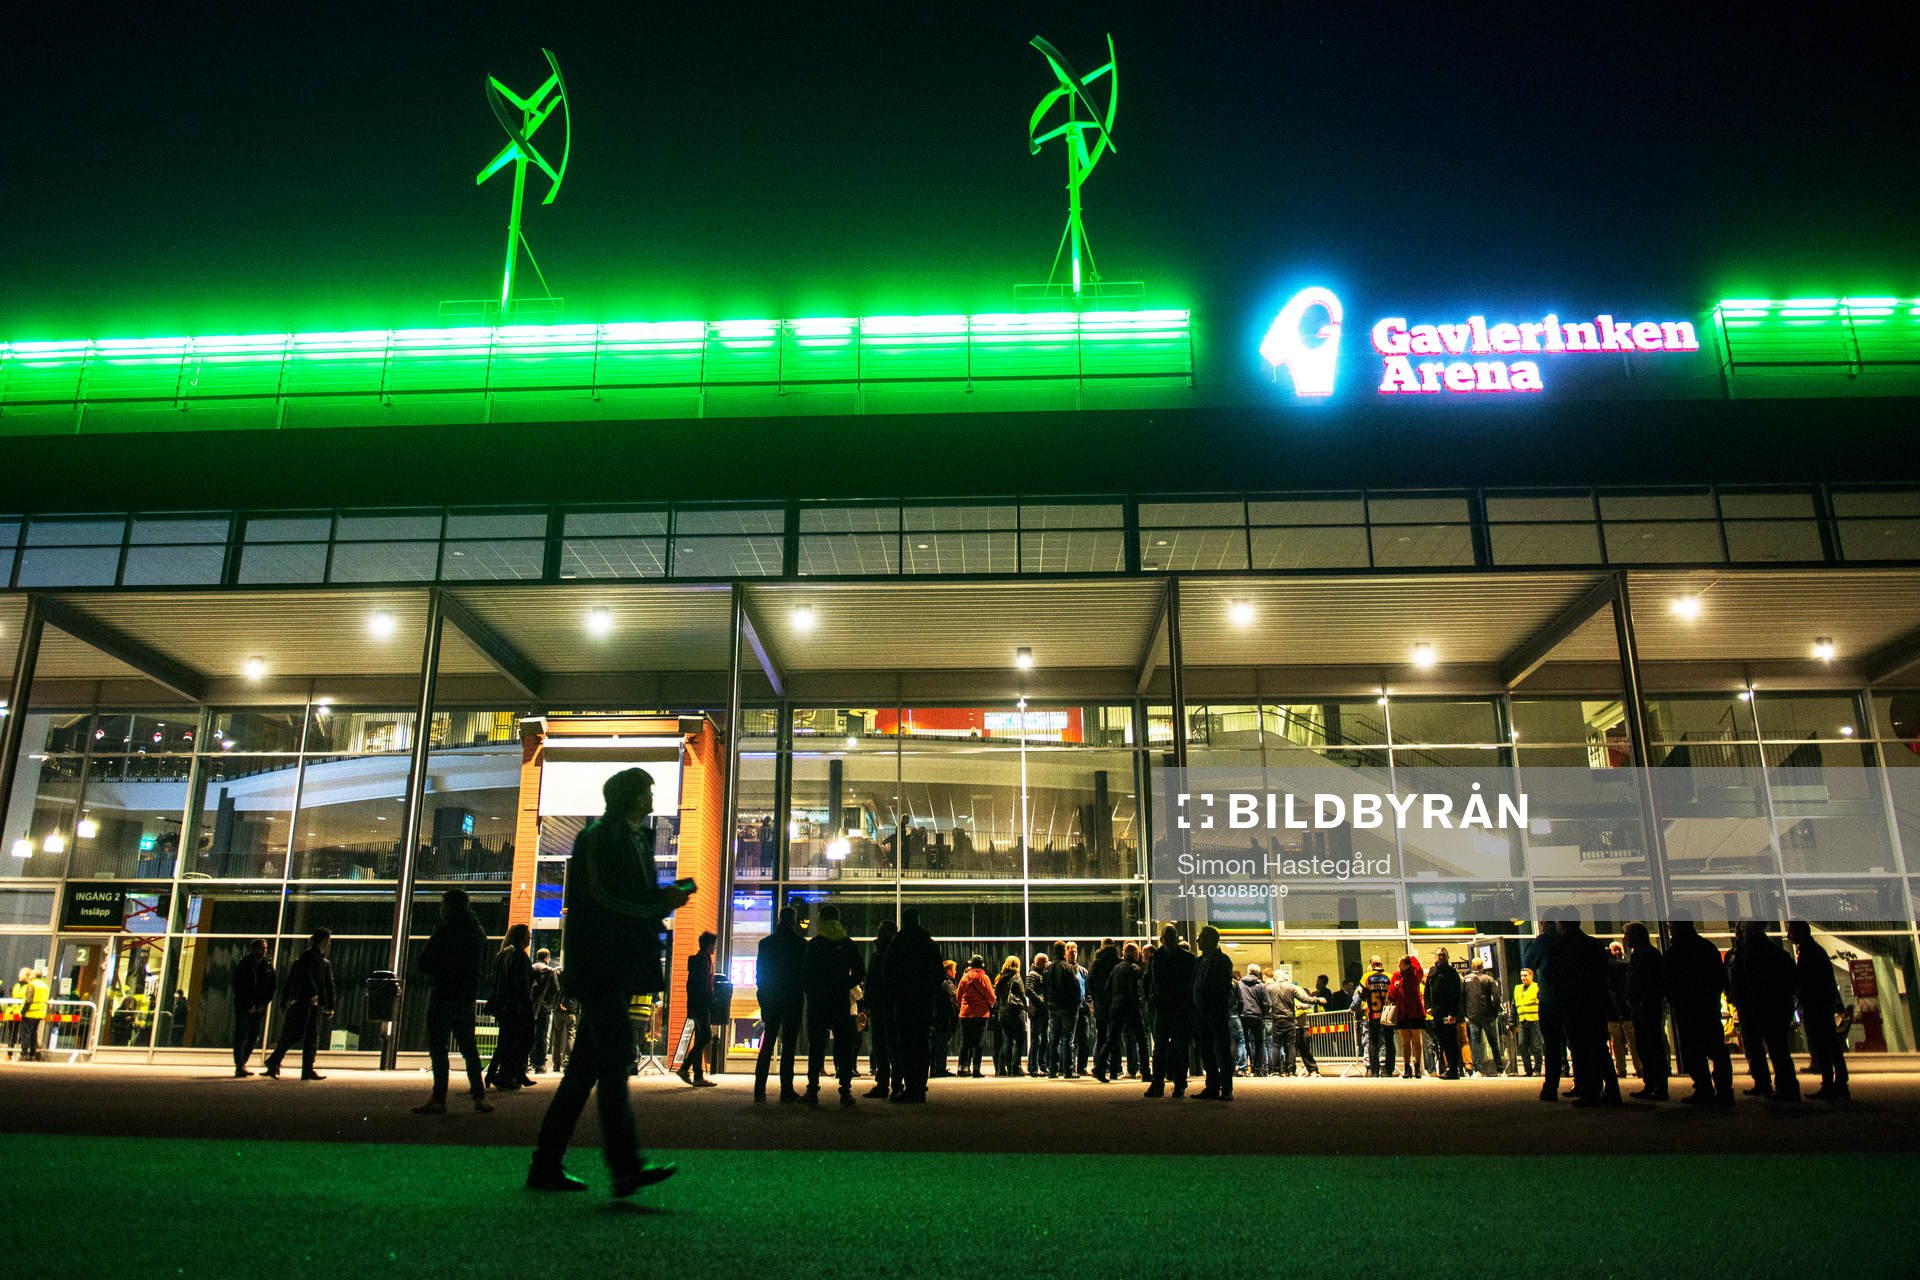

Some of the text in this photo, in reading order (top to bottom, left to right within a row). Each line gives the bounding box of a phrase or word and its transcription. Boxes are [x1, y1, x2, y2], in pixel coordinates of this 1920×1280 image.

[1371, 313, 1699, 356] Gavlerinken
[1378, 355, 1543, 394] Arena
[75, 891, 120, 901] INGÅNG 2
[81, 907, 110, 917] Insläpp
[76, 949, 87, 961] 2
[1483, 951, 1489, 962] 5
